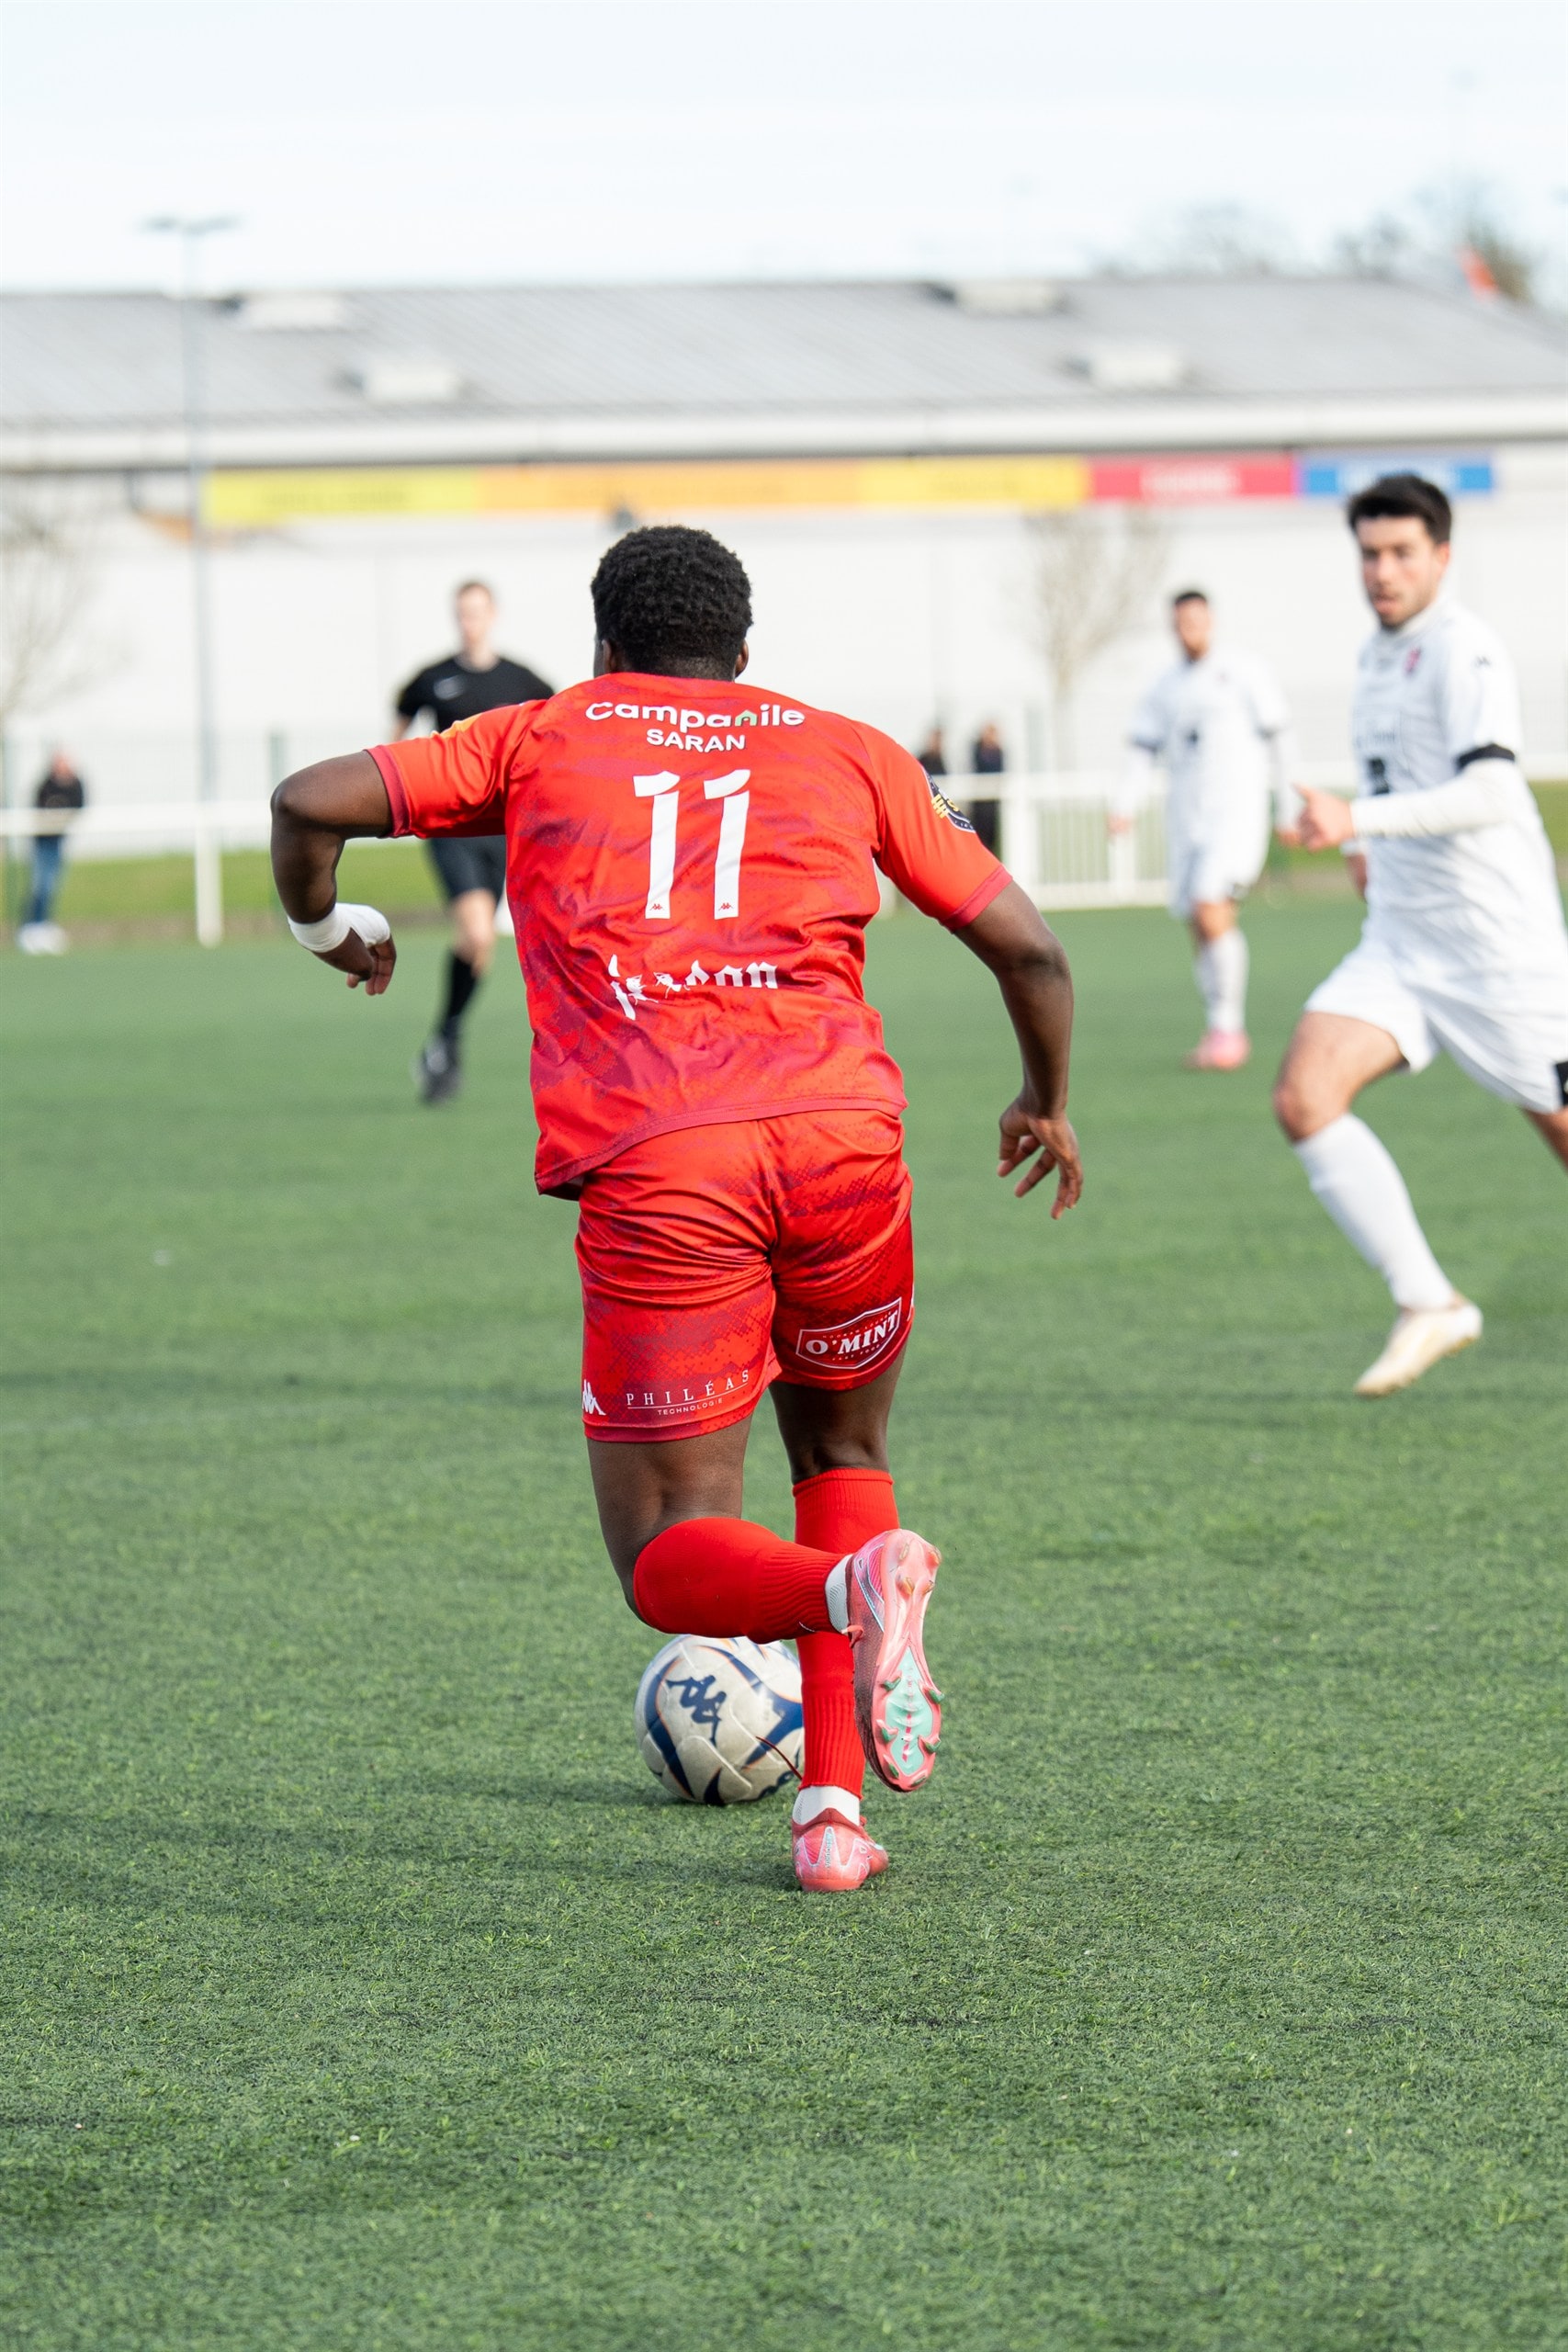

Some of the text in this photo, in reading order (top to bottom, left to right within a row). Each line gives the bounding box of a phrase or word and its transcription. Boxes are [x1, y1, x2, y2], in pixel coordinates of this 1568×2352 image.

[647, 729, 745, 752] SARAN
[633, 769, 750, 920] 11
[806, 1309, 898, 1355] O'MINT
[626, 1370, 749, 1406] PHILÉAS
[657, 1398, 723, 1416] TECHNOLOGIE
